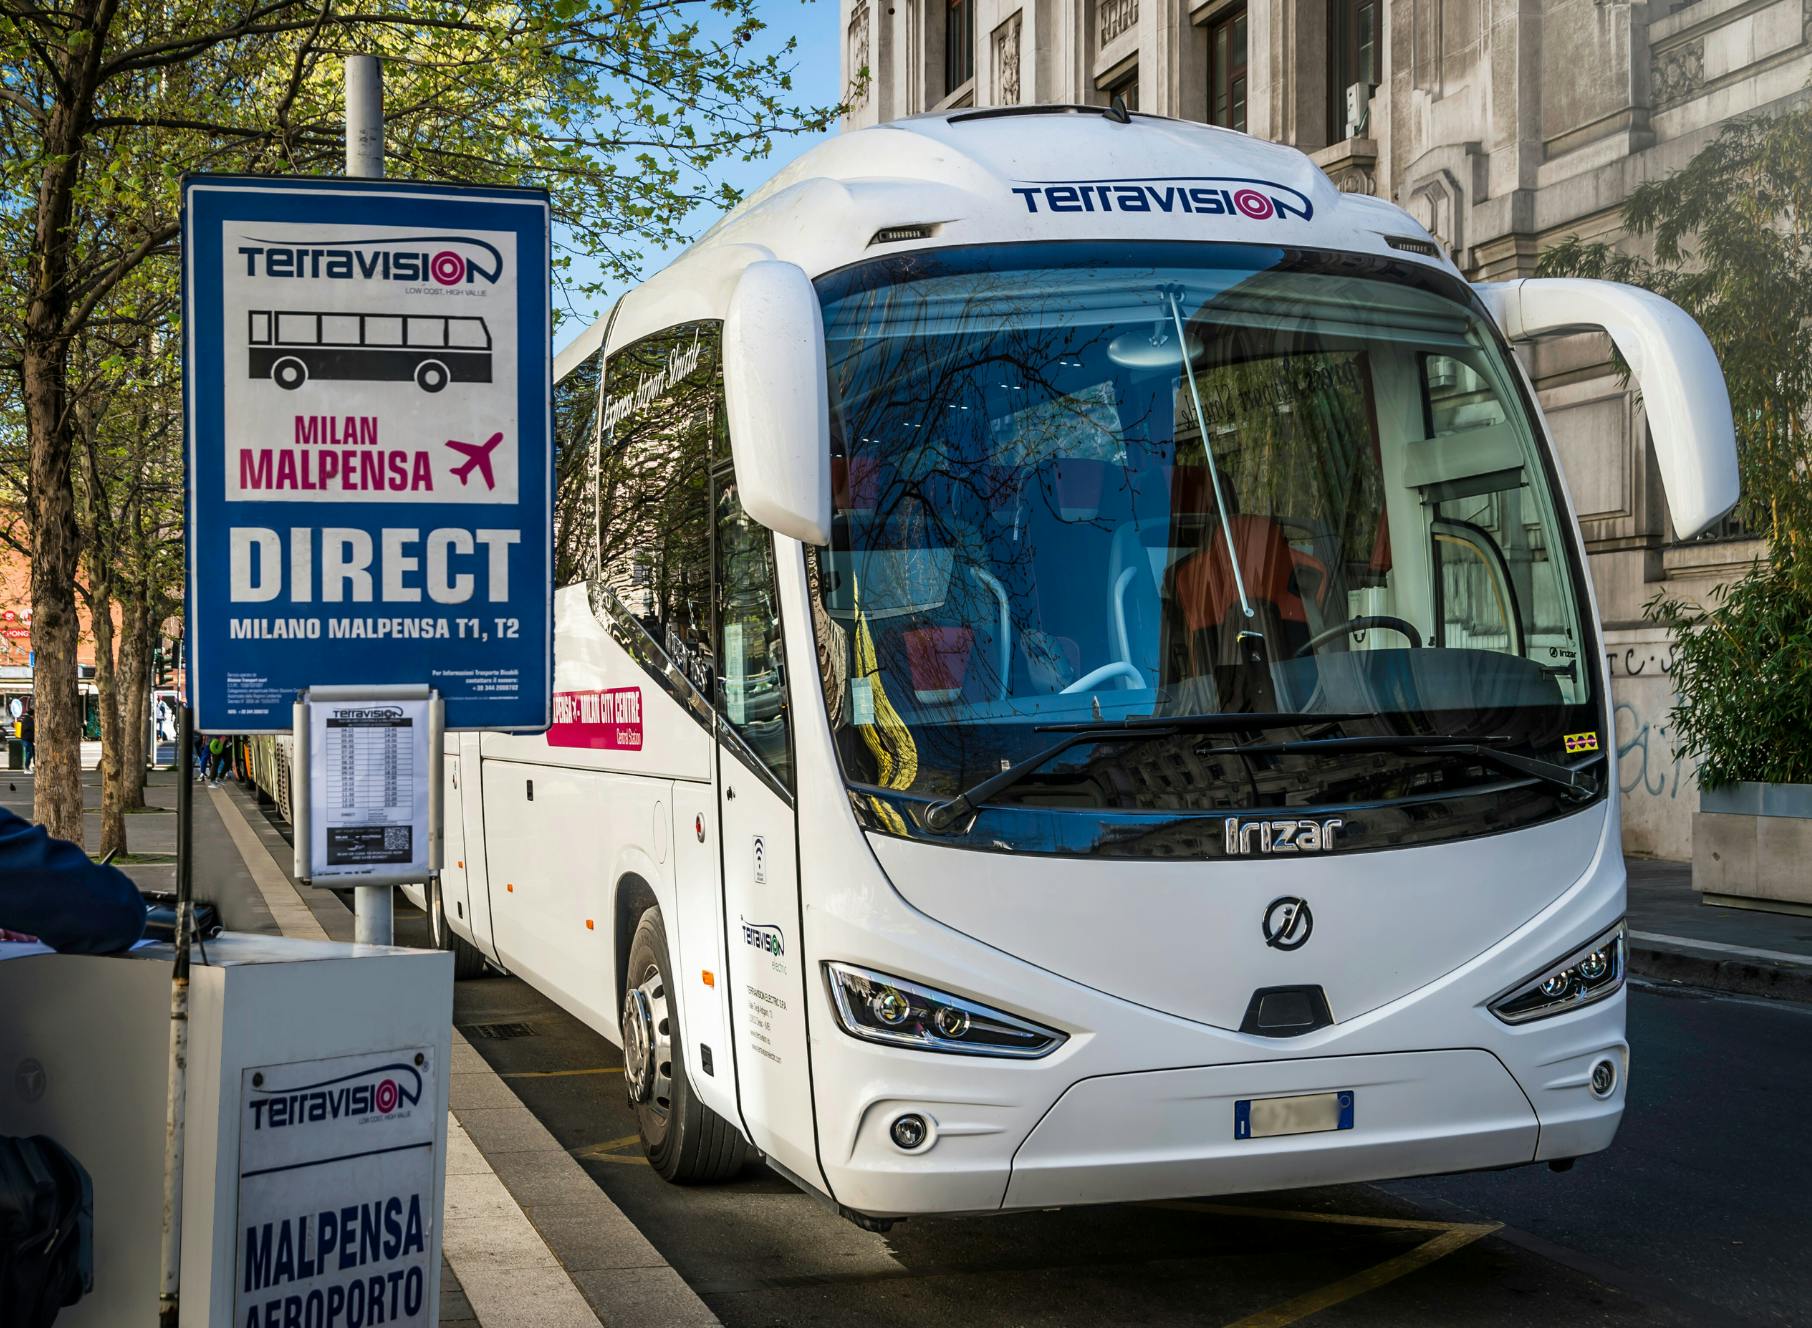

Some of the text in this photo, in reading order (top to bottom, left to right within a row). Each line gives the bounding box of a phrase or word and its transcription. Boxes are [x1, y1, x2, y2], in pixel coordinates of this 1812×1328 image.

[294, 415, 378, 445] MILAN
[239, 449, 434, 492] MALPENSA
[229, 527, 521, 605] DIRECT
[229, 617, 520, 642] MILANO MALPENSA T1, T2
[601, 692, 615, 724] CITY
[615, 691, 640, 724] CENTRE
[1225, 817, 1342, 854] Irizar
[244, 1192, 425, 1293] MALPENSA
